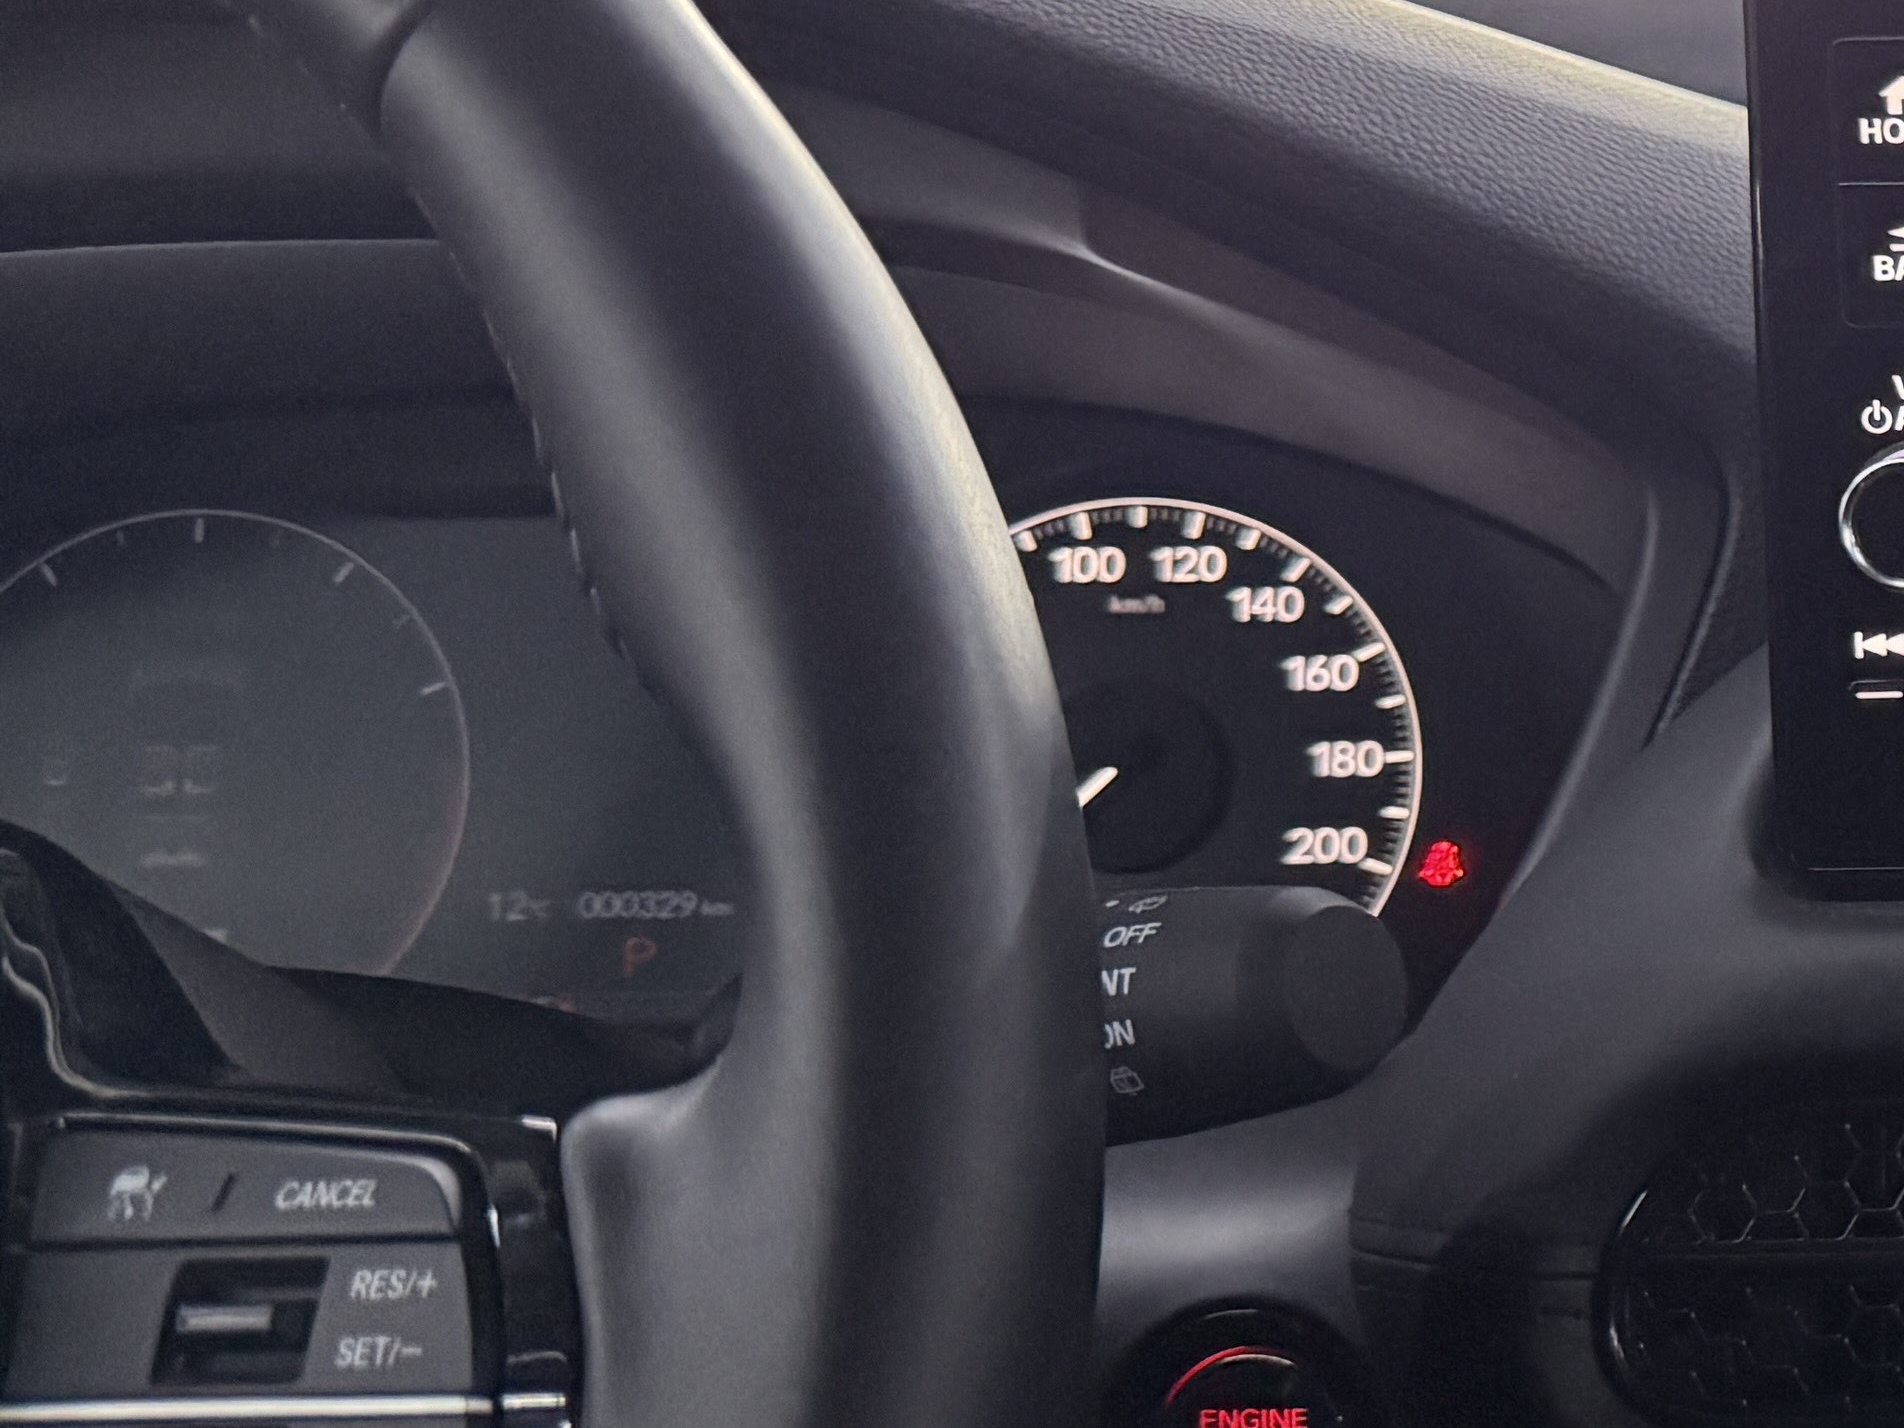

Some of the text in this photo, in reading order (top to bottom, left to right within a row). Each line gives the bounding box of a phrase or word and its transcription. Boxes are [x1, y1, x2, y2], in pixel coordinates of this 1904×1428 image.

[1048, 546, 1127, 584] 100
[1150, 545, 1228, 583] 120
[1226, 585, 1305, 623] 140
[1280, 653, 1359, 692] 160
[1308, 740, 1384, 778] 180
[1281, 826, 1368, 864] 200
[1103, 922, 1163, 948] OFF
[622, 936, 658, 976] P
[273, 1178, 378, 1210] CANCEL
